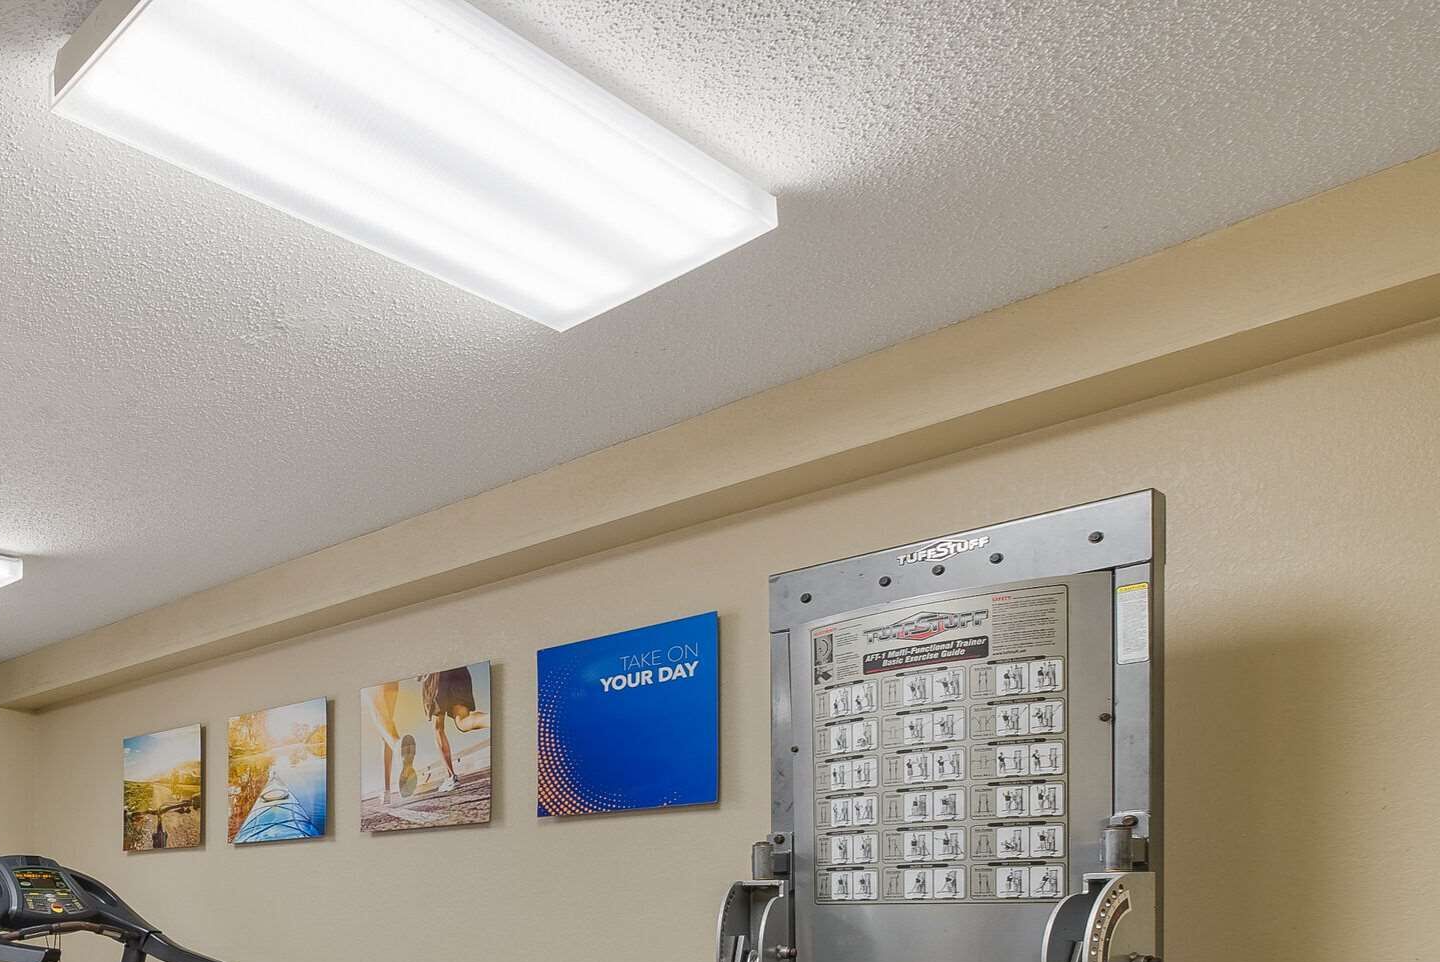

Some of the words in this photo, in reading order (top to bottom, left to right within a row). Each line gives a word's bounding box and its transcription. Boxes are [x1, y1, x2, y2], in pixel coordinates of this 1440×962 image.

[956, 638, 987, 649] Trainer
[620, 650, 661, 671] TAKE
[668, 642, 699, 663] ON
[882, 657, 904, 667] Basic
[904, 652, 940, 663] Exercise
[941, 648, 966, 658] Guide
[600, 670, 654, 692] YOUR
[658, 661, 699, 683] DAY
